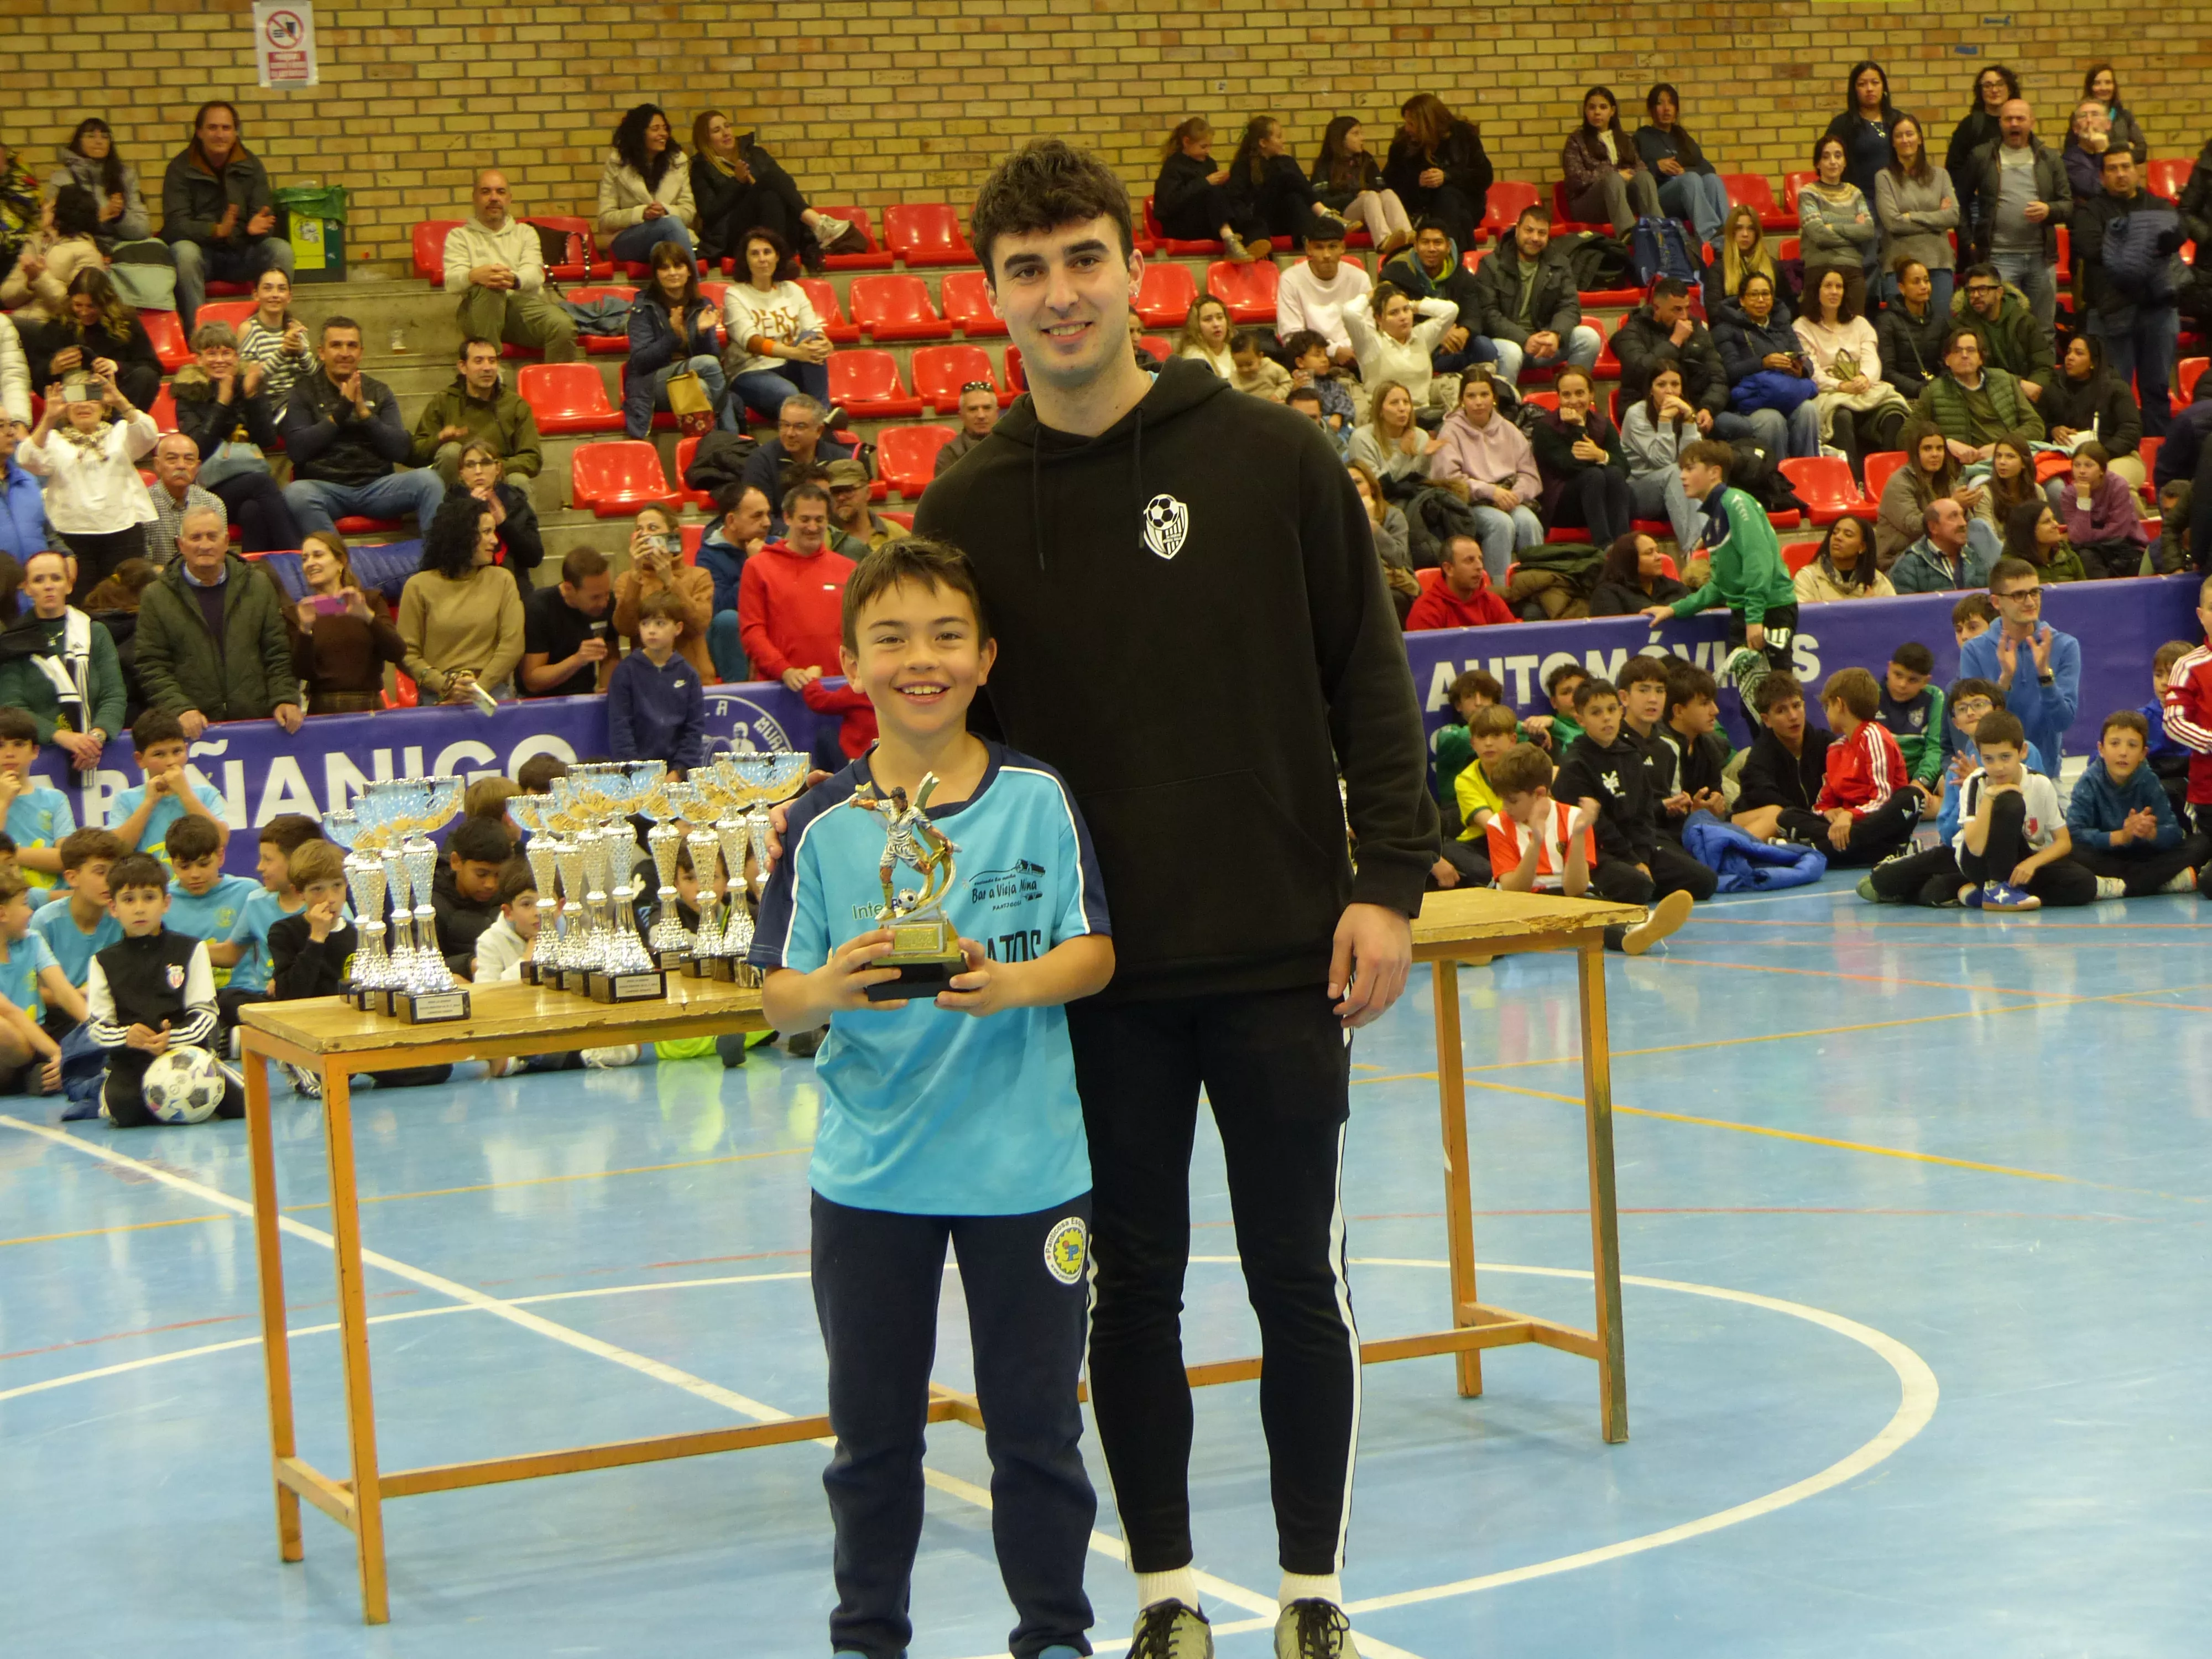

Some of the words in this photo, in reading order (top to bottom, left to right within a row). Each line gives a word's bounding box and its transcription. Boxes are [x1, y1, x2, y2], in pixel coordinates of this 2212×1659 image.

[972, 888, 986, 904] Bar
[989, 889, 995, 899] a
[1045, 1220, 1070, 1253] Panticosa
